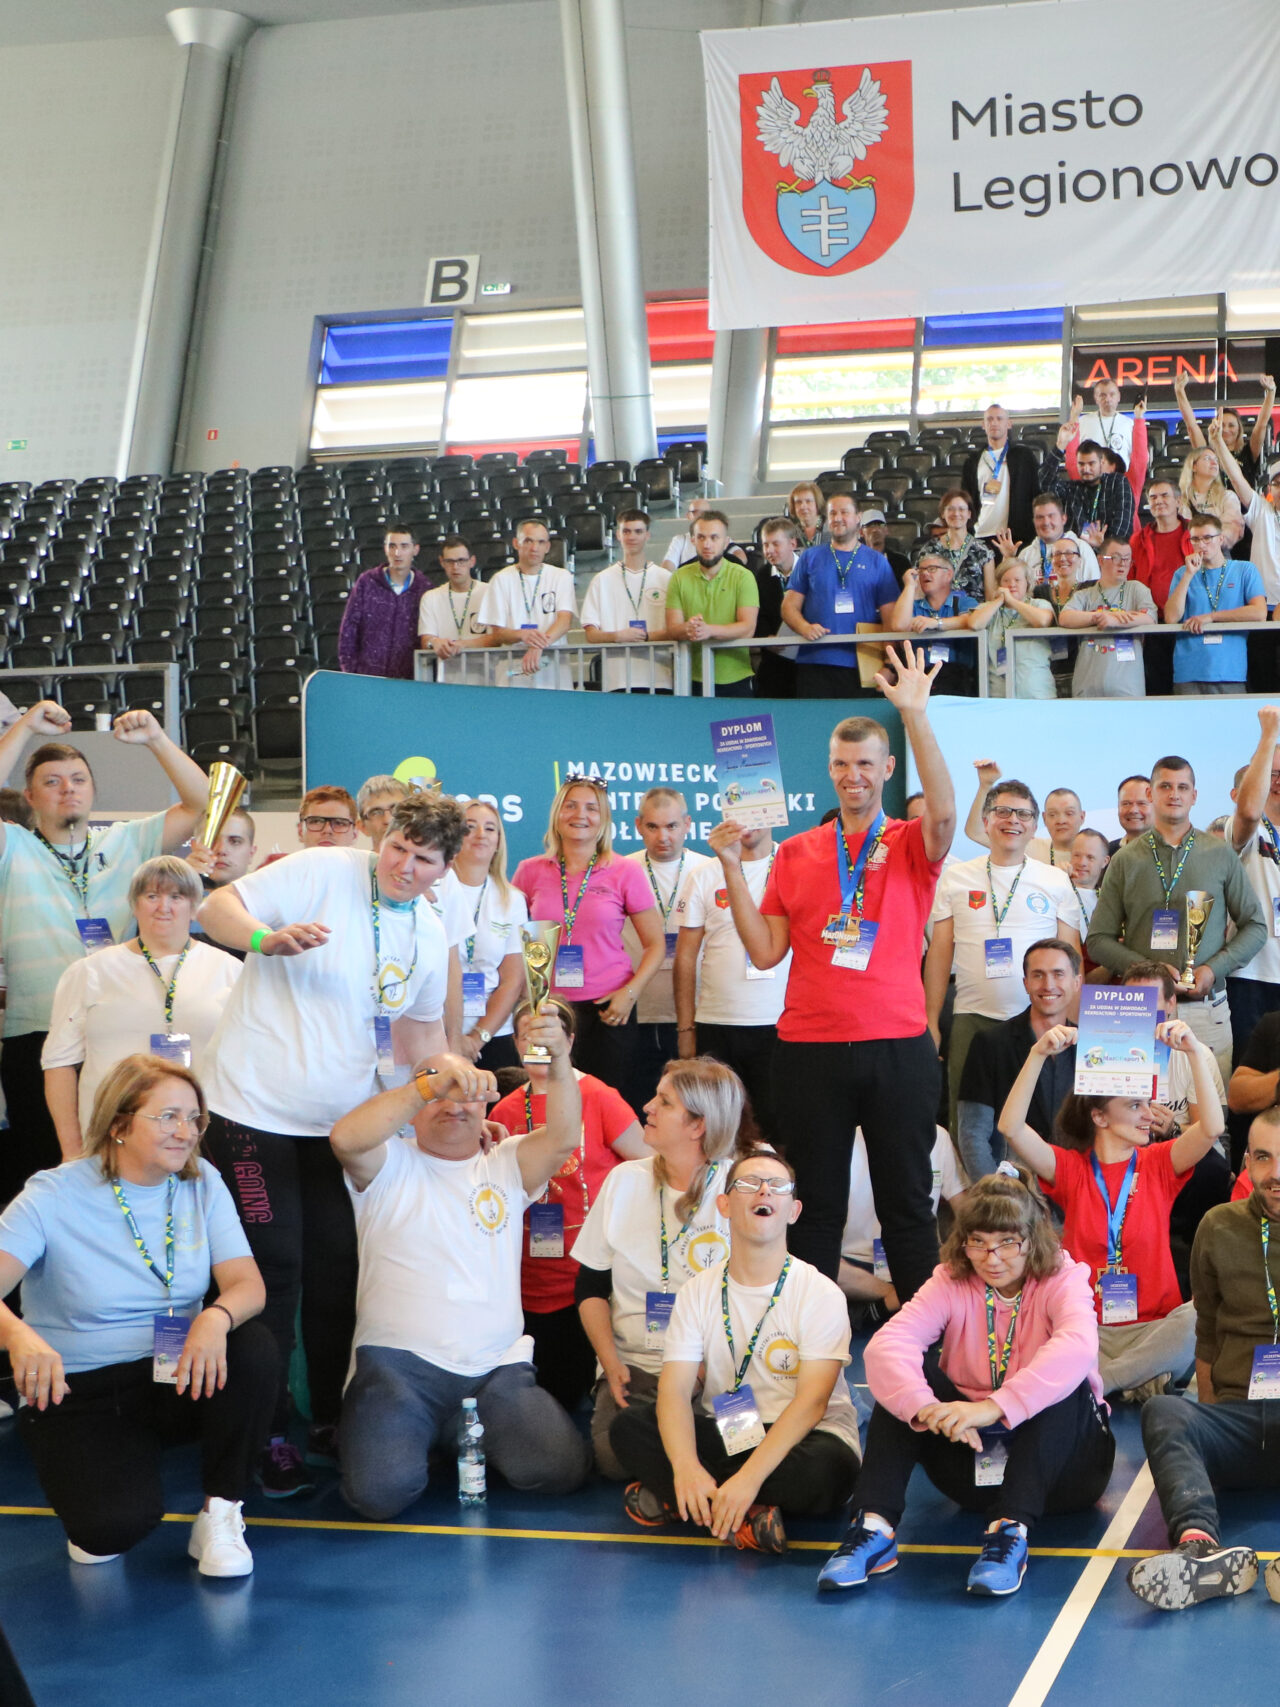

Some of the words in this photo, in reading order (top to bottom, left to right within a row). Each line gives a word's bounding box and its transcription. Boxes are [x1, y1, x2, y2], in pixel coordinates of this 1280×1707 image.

[951, 89, 1143, 141] Miasto
[952, 151, 1279, 218] Legionowo
[431, 259, 469, 303] B
[1084, 355, 1238, 388] ARENA
[721, 722, 762, 736] DYPLOM
[1094, 991, 1144, 1002] DYPLOM
